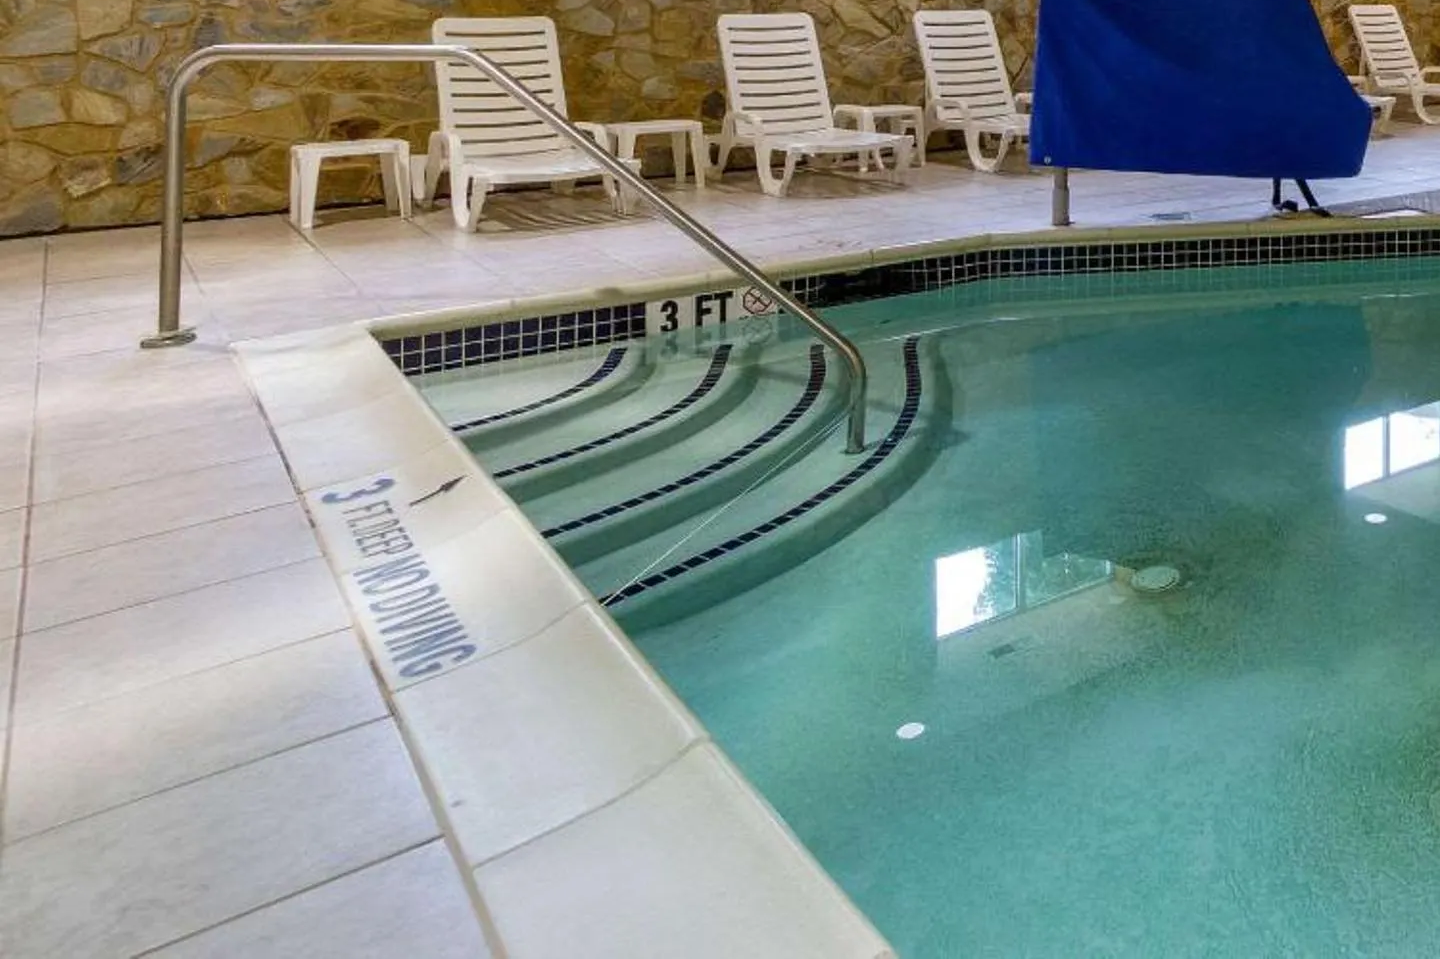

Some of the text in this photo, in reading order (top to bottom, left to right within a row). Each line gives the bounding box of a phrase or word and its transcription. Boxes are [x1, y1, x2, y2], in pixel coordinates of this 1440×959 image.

[660, 290, 734, 332] 3 FT
[321, 478, 396, 504] 3
